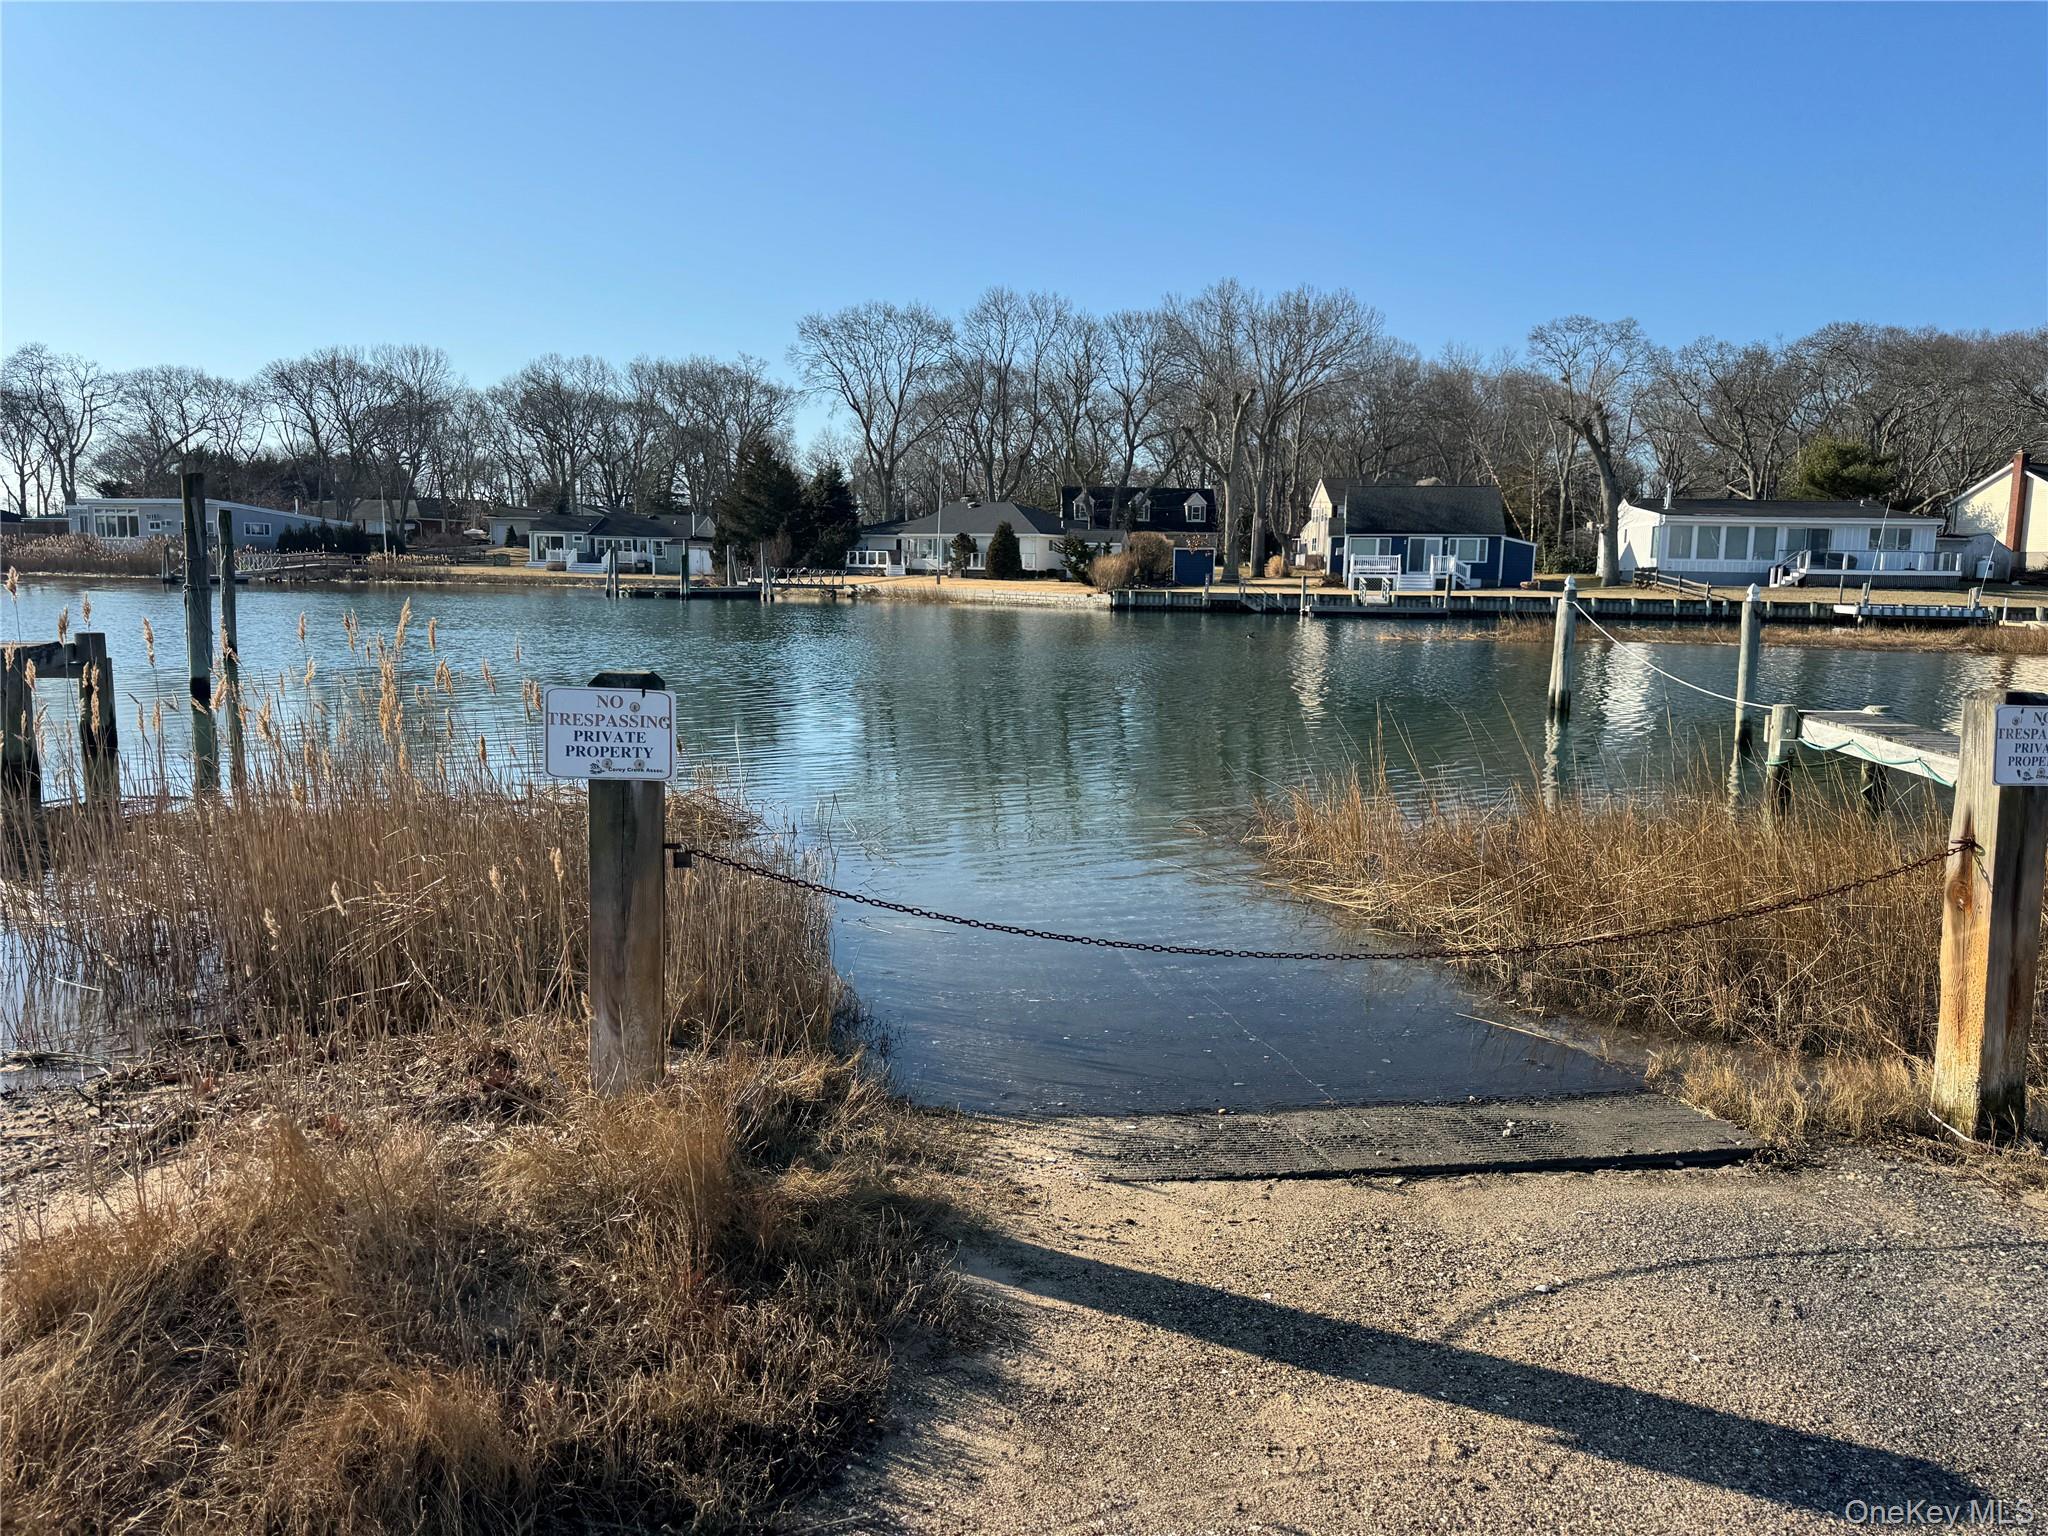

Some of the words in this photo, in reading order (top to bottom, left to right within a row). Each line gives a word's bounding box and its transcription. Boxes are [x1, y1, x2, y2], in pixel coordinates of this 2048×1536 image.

[597, 695, 624, 709] NO
[548, 712, 671, 729] TRESPASSING
[574, 730, 647, 744] PRIVATE
[565, 745, 654, 759] PROPERTY
